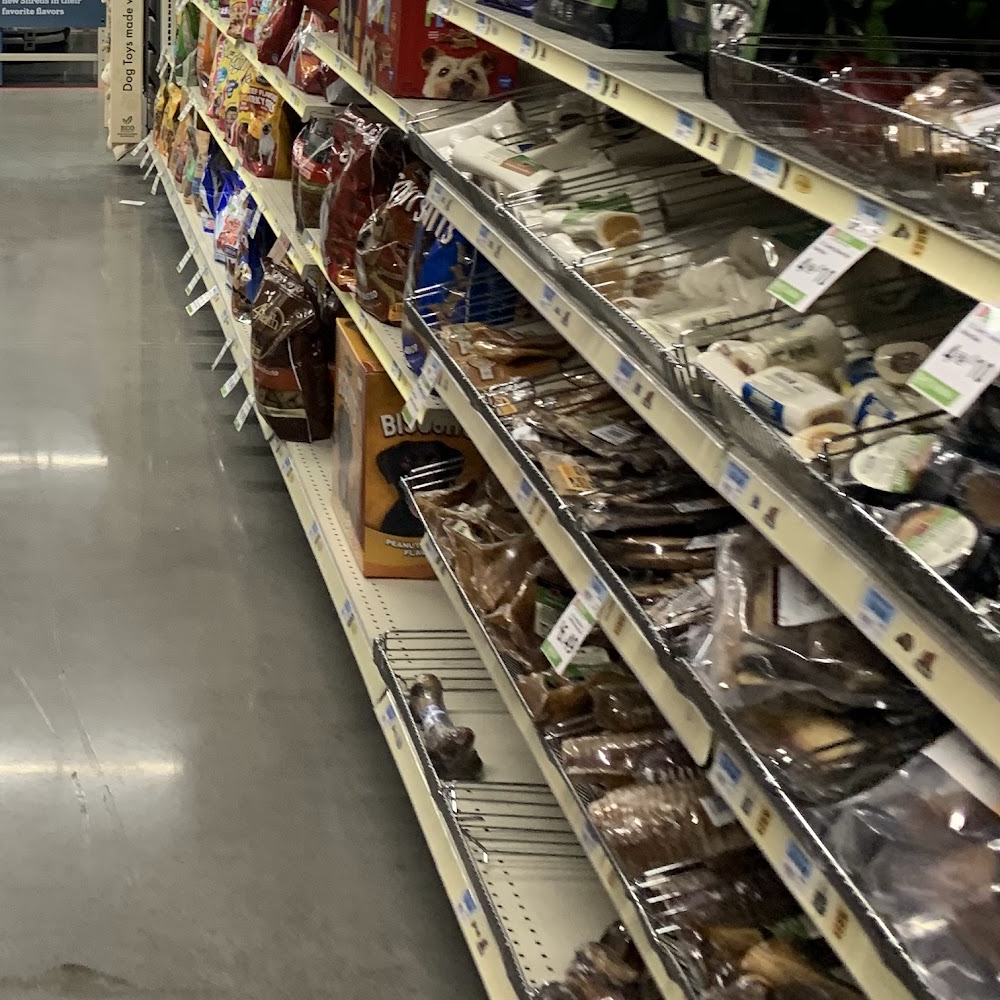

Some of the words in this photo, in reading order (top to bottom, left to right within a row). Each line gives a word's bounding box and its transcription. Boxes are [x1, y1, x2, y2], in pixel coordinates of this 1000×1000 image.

[1, 7, 35, 15] favorite
[35, 7, 65, 15] flavors
[122, 12, 134, 39] made
[122, 42, 136, 66] Toys
[122, 68, 136, 92] Dog
